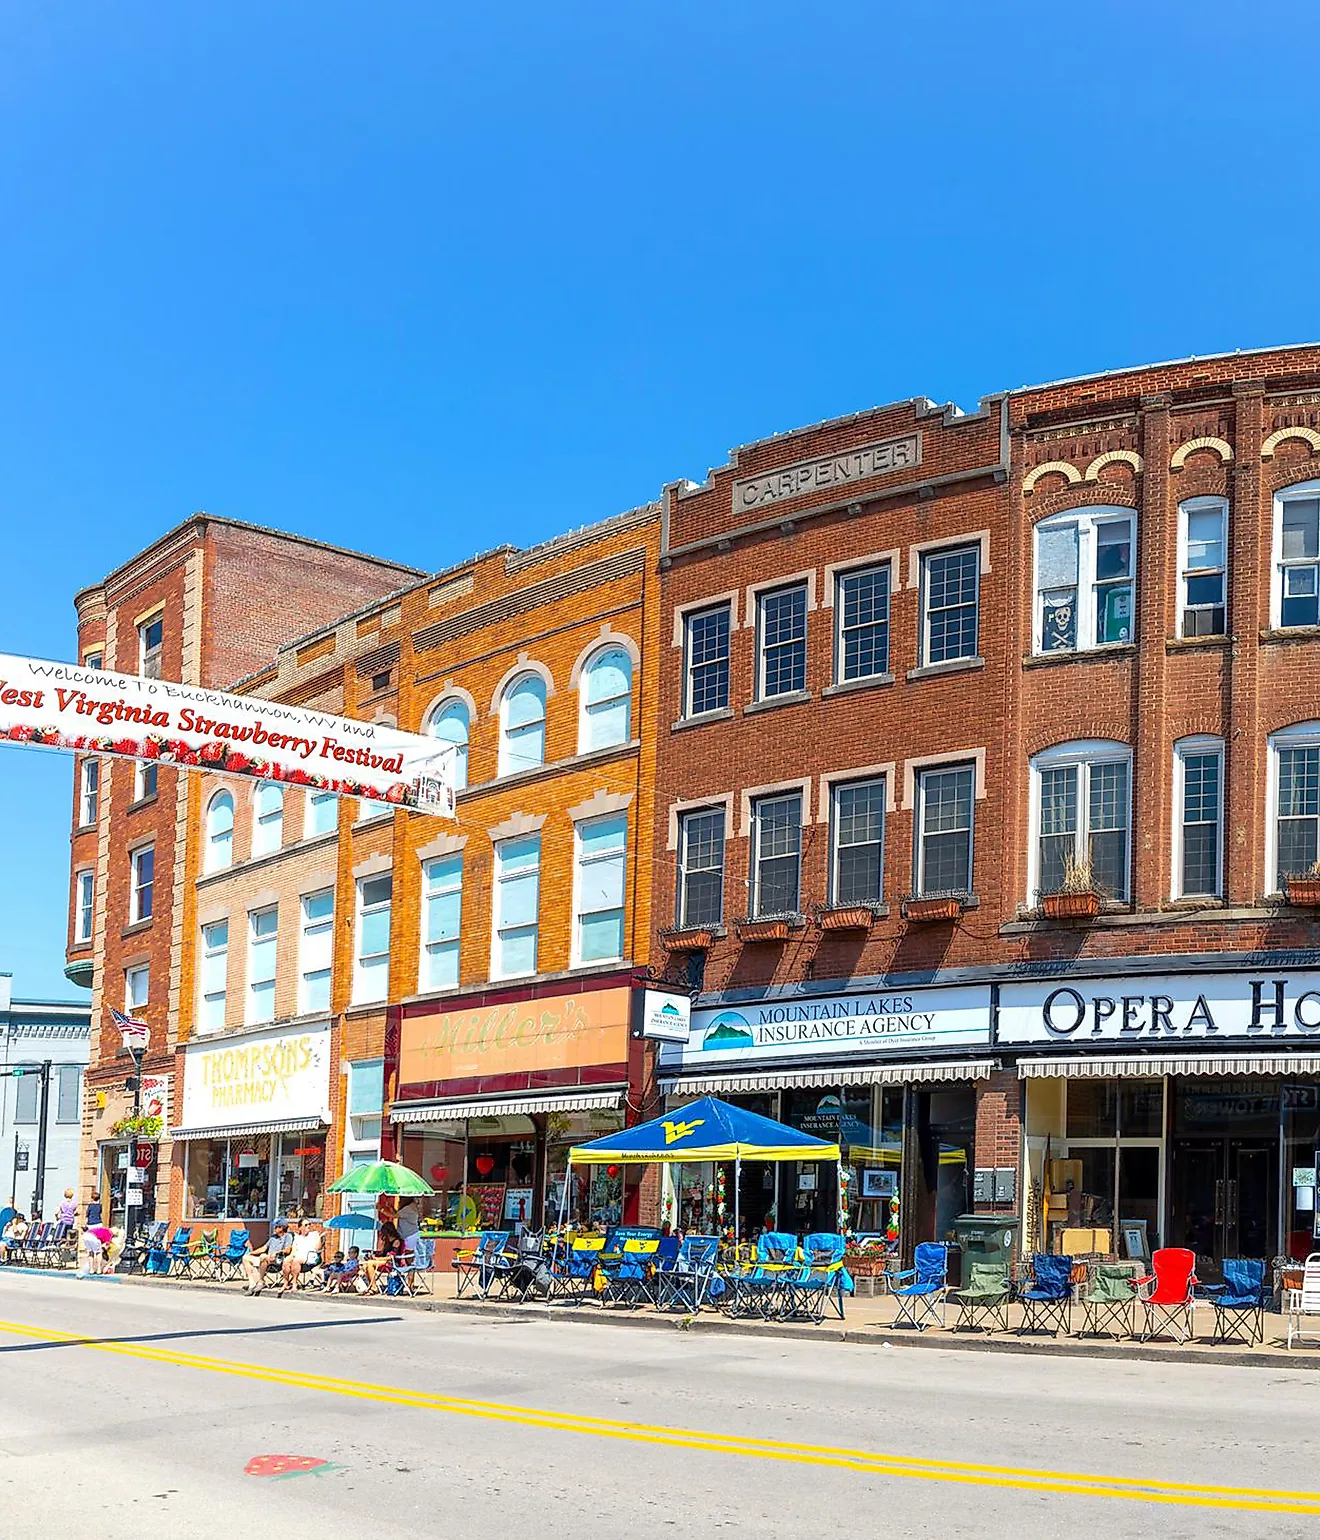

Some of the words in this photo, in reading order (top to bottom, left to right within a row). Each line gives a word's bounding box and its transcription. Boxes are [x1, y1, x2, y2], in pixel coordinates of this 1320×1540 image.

[742, 443, 911, 506] CARPENTER
[28, 662, 128, 691] Welcome
[132, 679, 158, 694] To
[162, 683, 302, 725] Buckhannon,
[303, 713, 337, 730] WV
[342, 722, 377, 740] and
[54, 687, 171, 726] Virginia
[177, 707, 318, 760] Strawberry
[319, 736, 405, 775] Festival
[757, 1019, 857, 1043] INSURANCE
[859, 1013, 937, 1035] AGENCY
[758, 1001, 851, 1025] MOUNTAIN
[854, 996, 914, 1016] LAKES
[1042, 986, 1219, 1036] OPERA
[201, 1036, 311, 1088] THOMPSONS
[212, 1079, 277, 1108] PHARMACY
